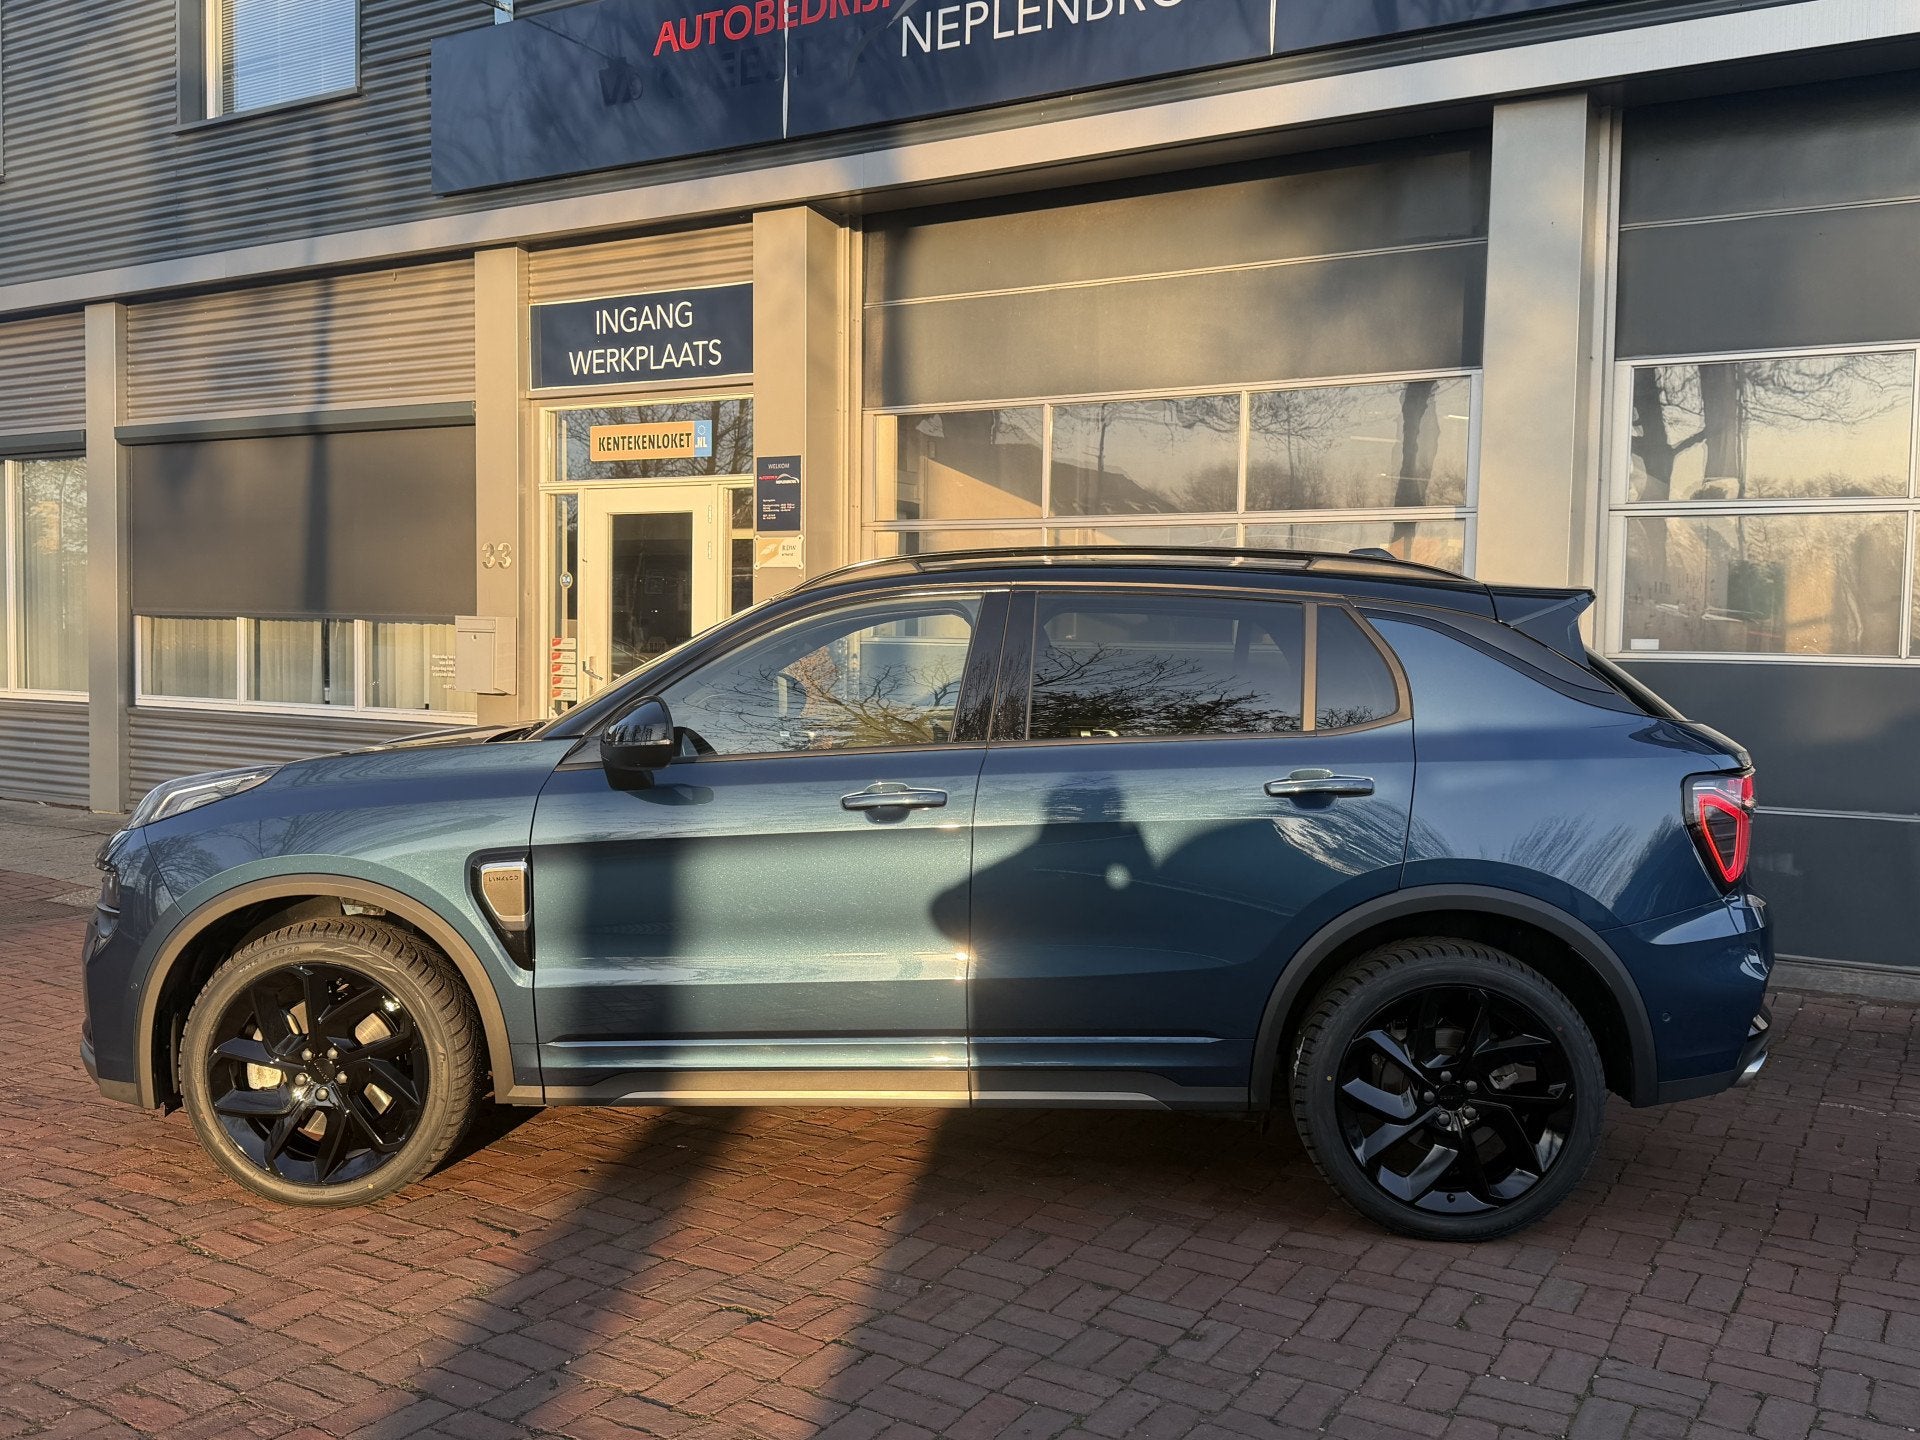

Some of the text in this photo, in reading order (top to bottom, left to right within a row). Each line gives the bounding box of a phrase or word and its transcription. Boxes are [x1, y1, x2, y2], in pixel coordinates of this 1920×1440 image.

[596, 301, 693, 335] INGANG
[569, 339, 722, 376] WERKPLAATS
[599, 432, 692, 451] KENTEKENLOKET
[482, 542, 512, 569] 33
